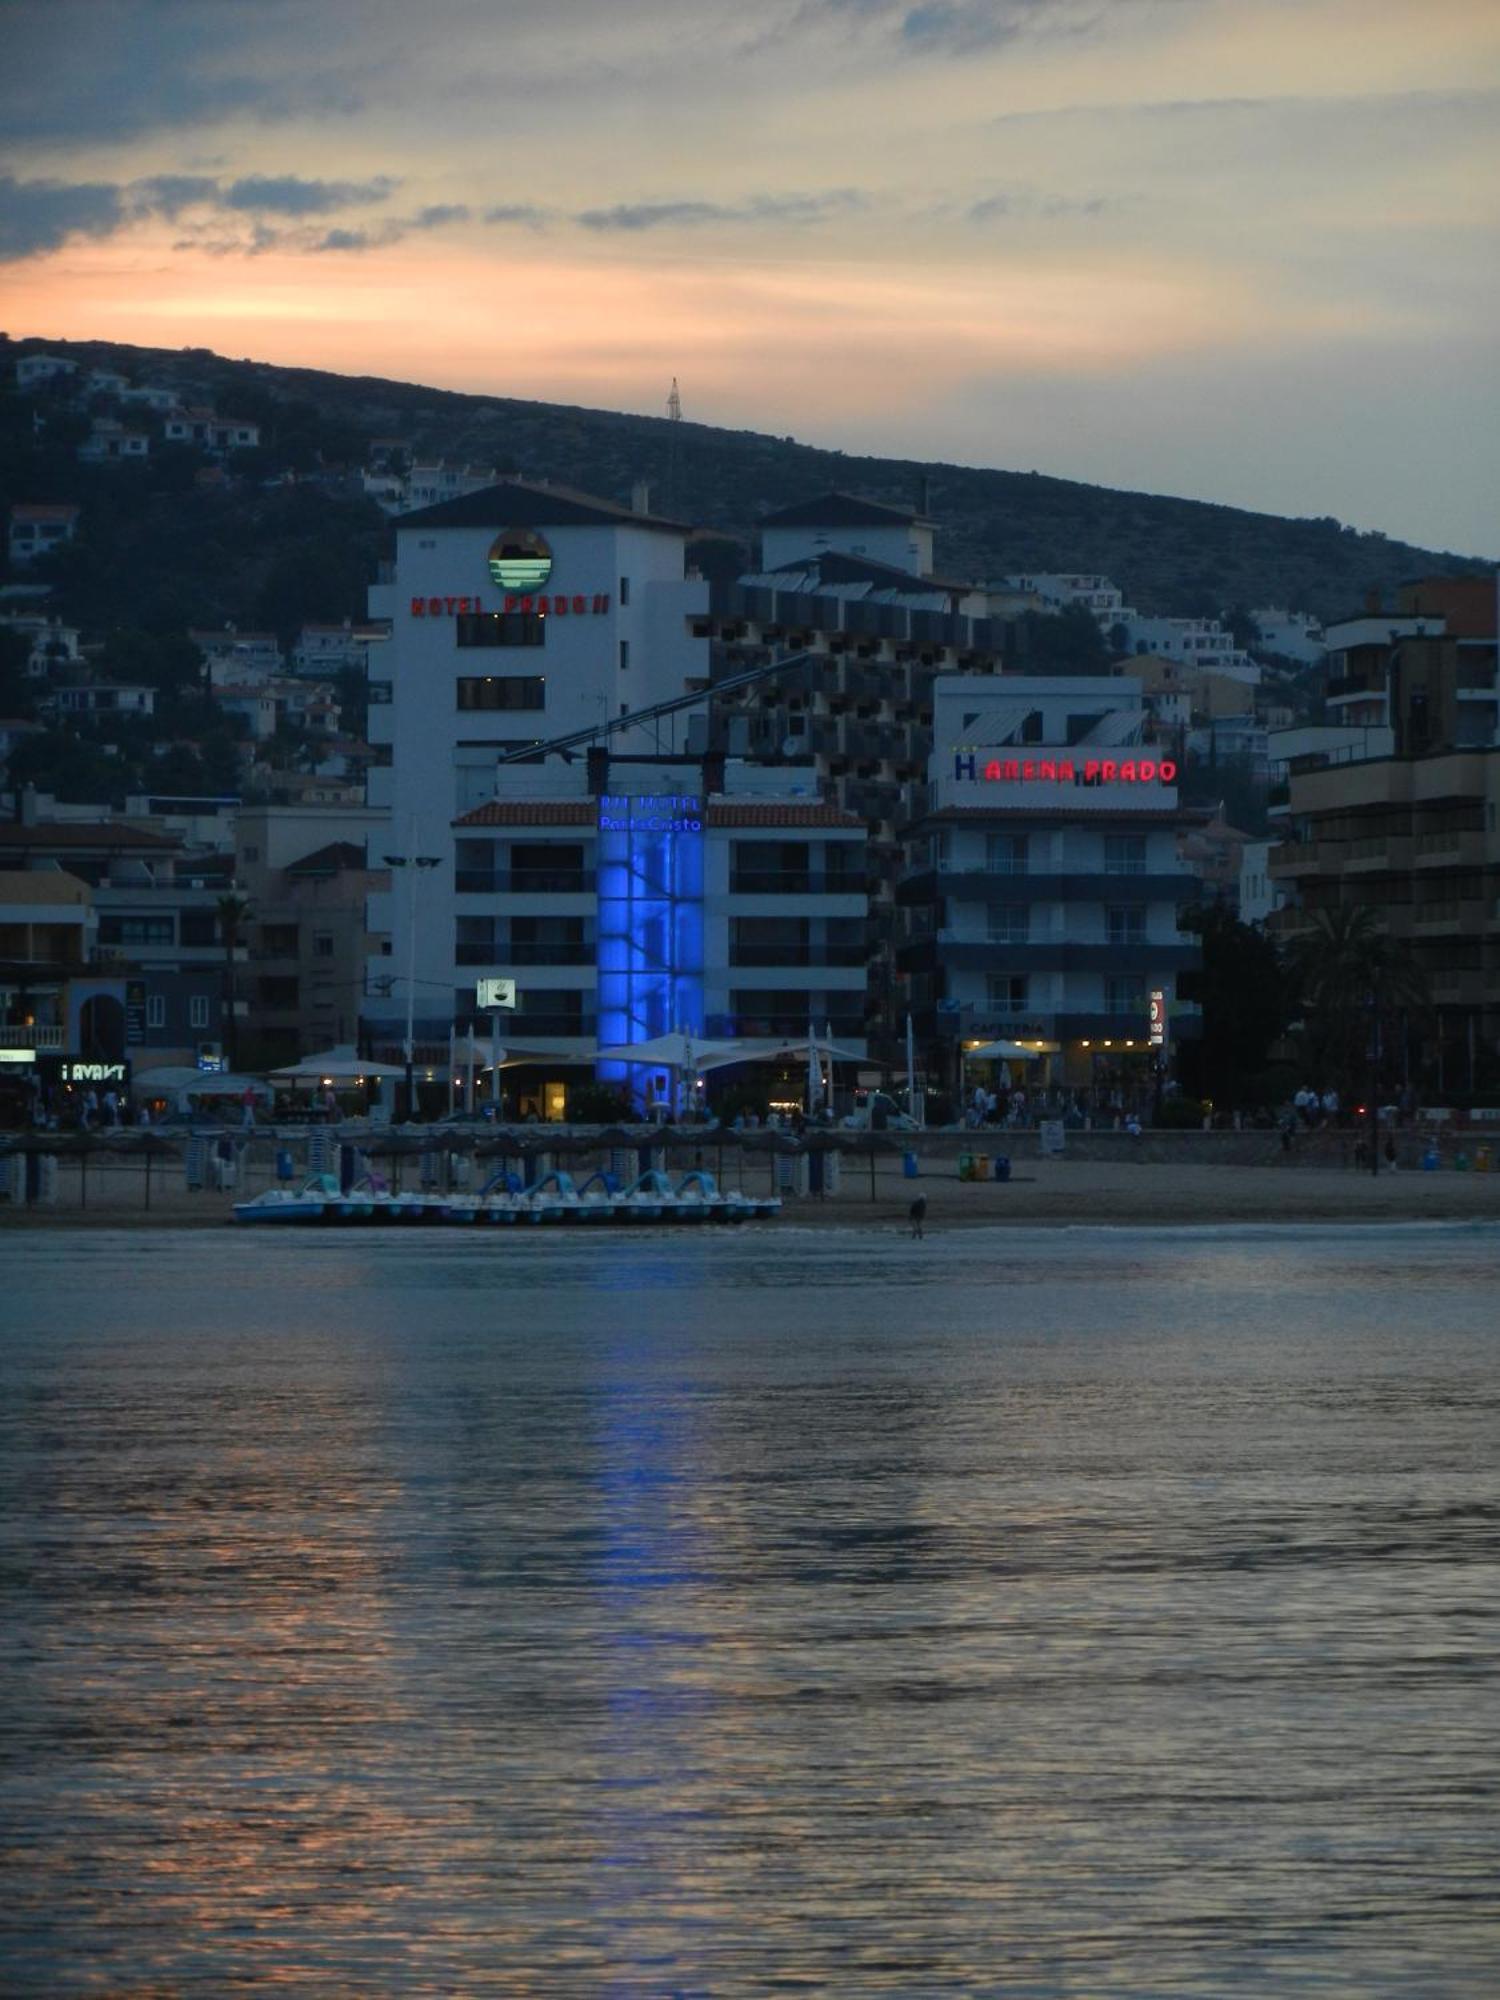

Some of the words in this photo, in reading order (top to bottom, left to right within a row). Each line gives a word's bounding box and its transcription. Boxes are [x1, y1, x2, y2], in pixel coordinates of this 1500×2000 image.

[411, 597, 482, 616] HOTEL
[503, 595, 585, 615] PRADO
[985, 759, 1075, 781] ARENA
[1084, 759, 1177, 781] PRADO
